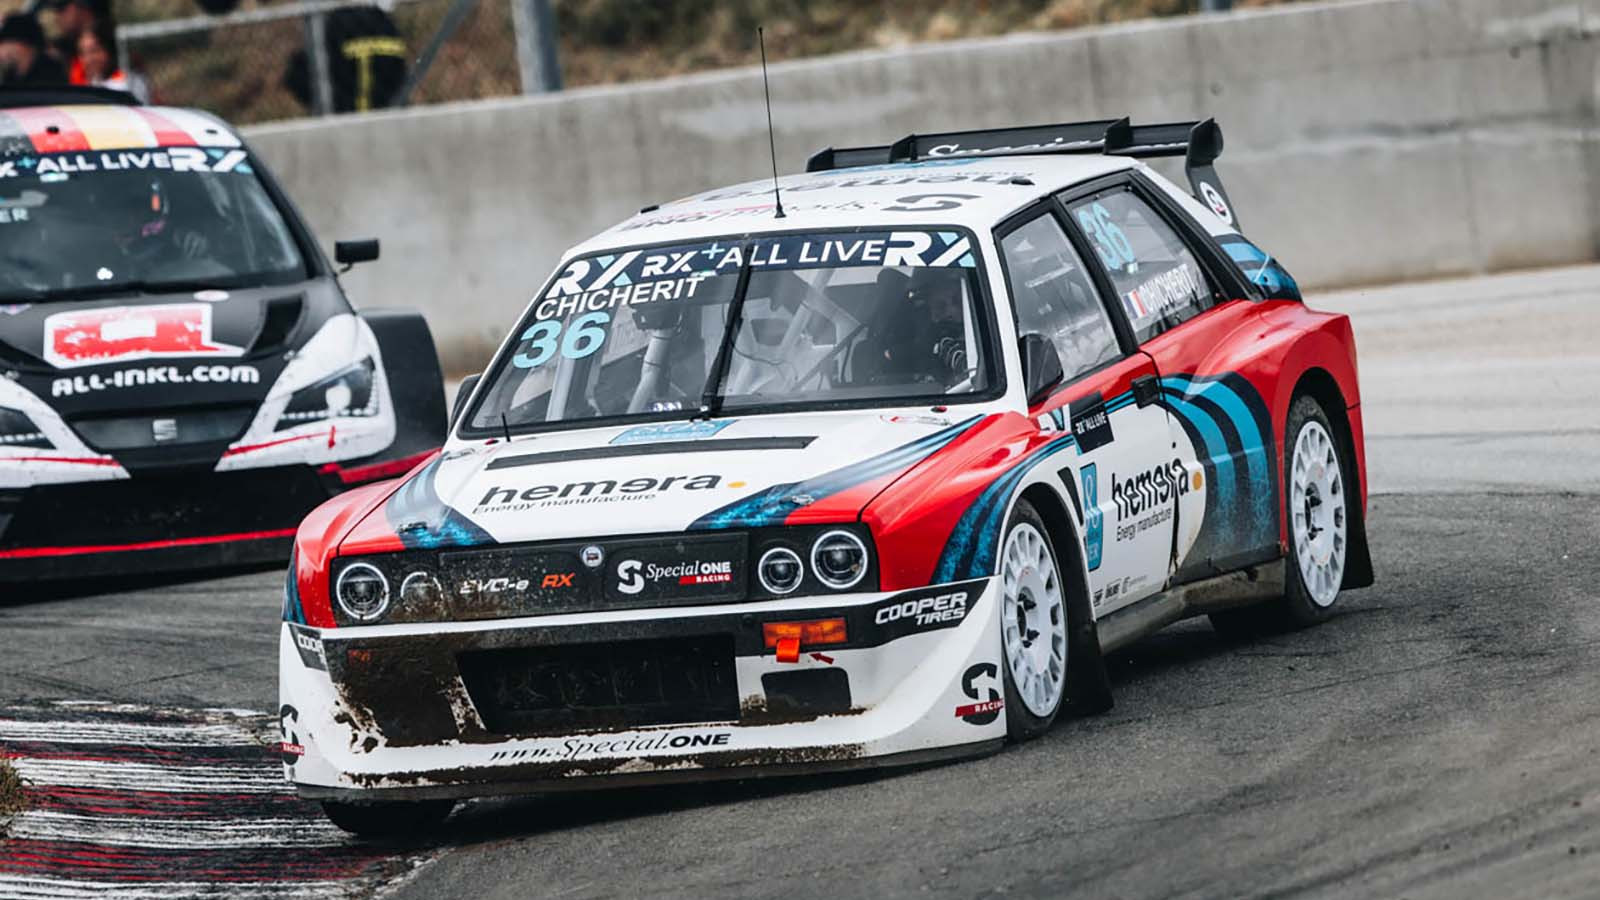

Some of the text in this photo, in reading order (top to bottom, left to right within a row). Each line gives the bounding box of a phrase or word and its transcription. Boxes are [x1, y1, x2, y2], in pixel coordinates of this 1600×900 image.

[36, 155, 97, 174] ALL
[100, 152, 171, 171] LIVE
[168, 147, 253, 174] RX
[882, 231, 977, 267] RX
[1078, 202, 1137, 271] 36
[717, 242, 787, 268] ALL
[799, 240, 885, 263] LIVE
[546, 250, 643, 299] RX
[535, 277, 705, 320] CHICHERIT
[513, 312, 611, 369] 36
[472, 493, 656, 515] Energy manufacture
[1116, 520, 1139, 542] Energy
[541, 571, 576, 589] RX
[696, 573, 731, 583] RACING
[876, 591, 969, 625] COOPER
[915, 607, 967, 627] TIRES
